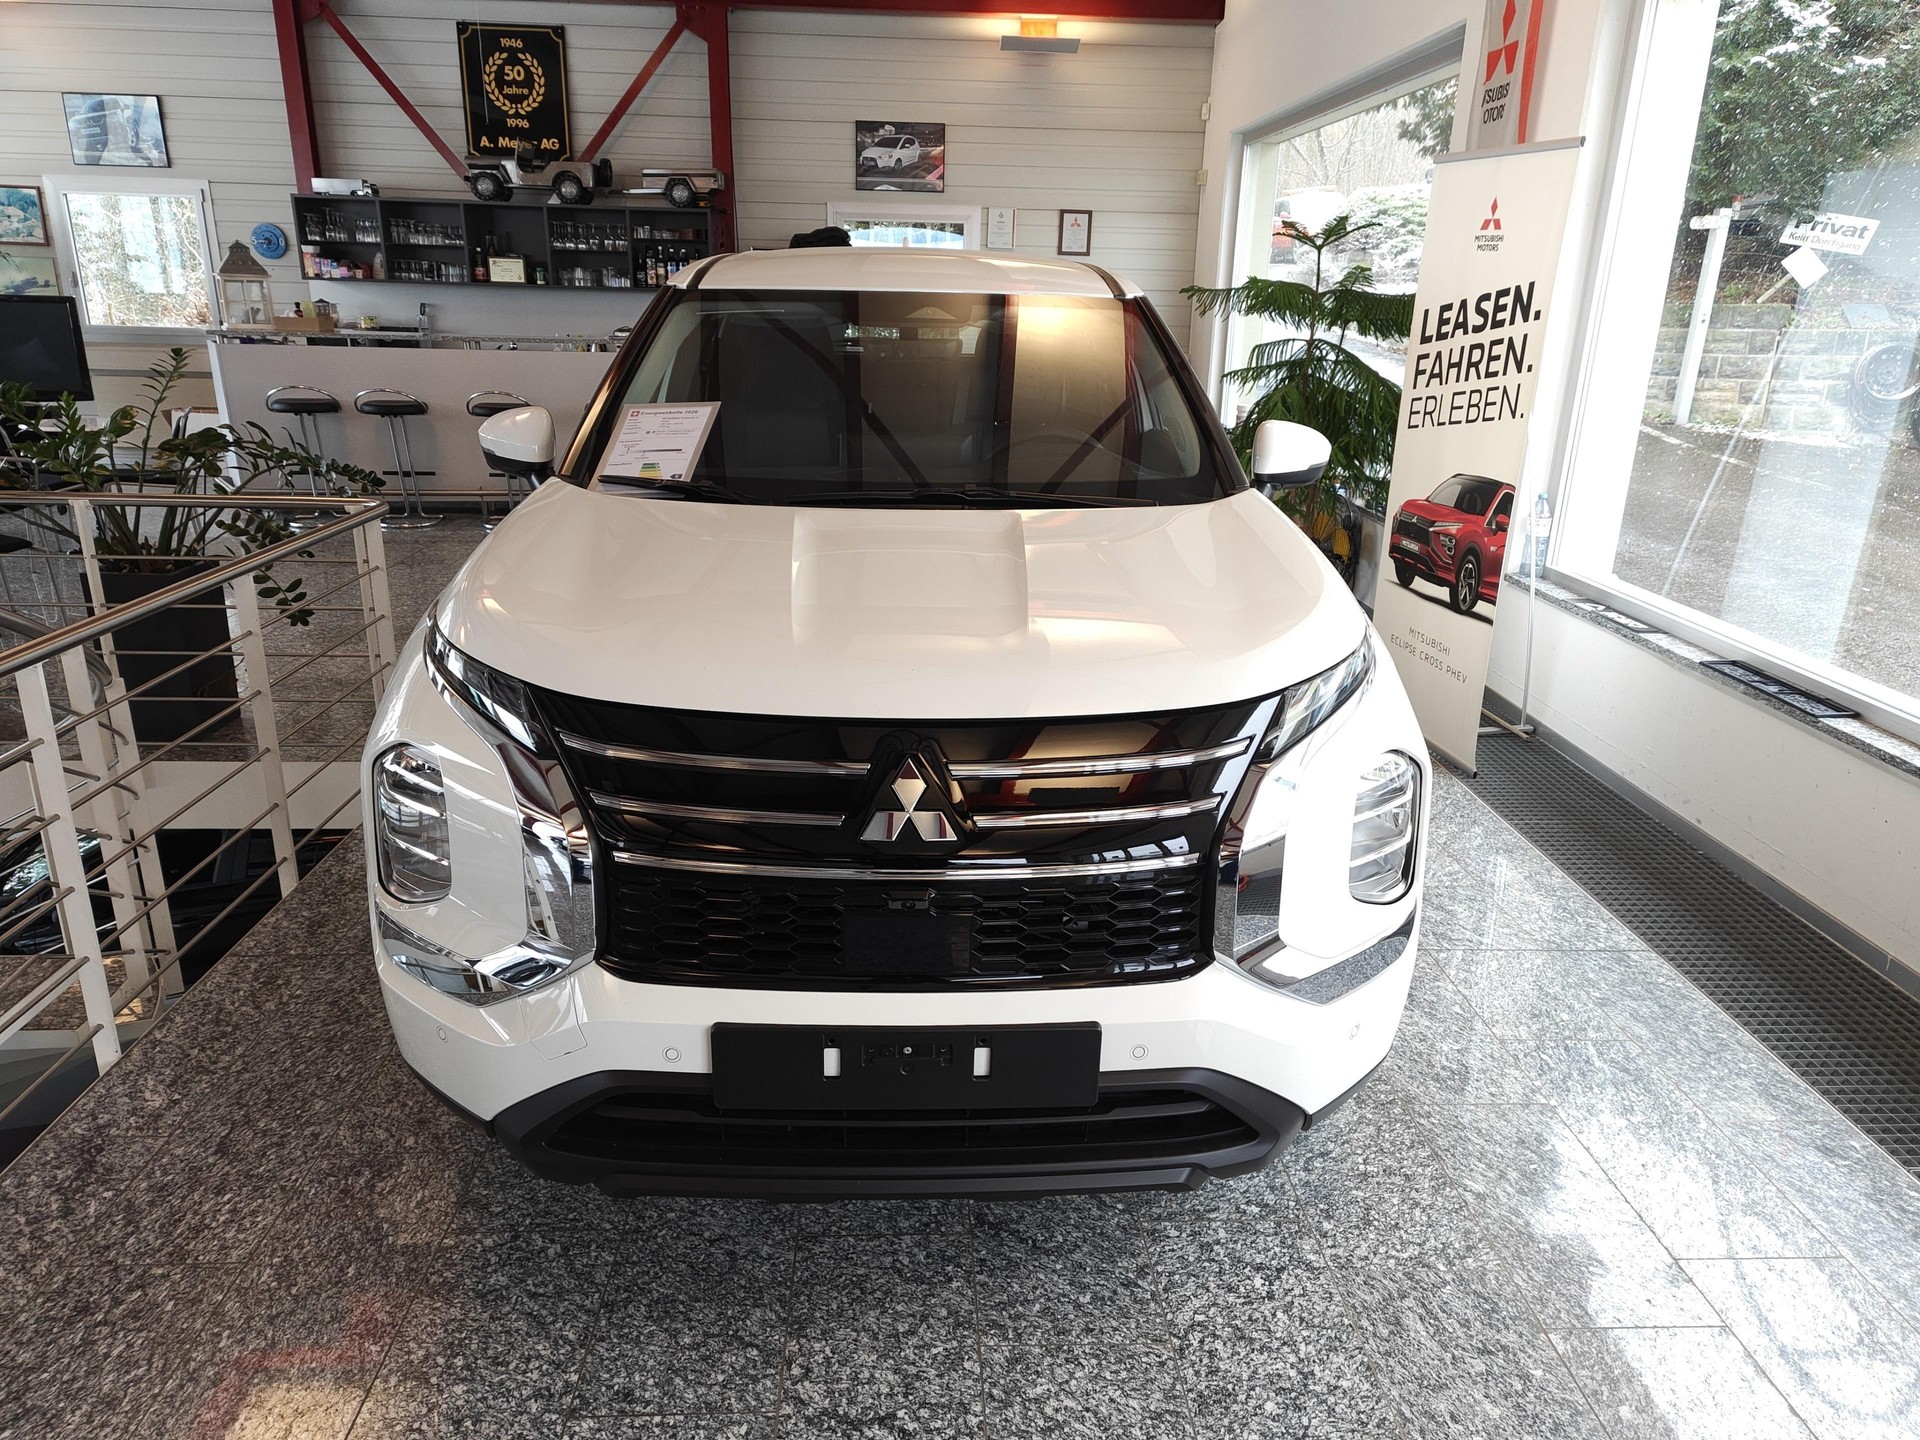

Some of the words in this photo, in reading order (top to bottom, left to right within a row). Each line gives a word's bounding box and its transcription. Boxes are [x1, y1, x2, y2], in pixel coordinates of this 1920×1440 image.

[500, 38, 523, 48] 1946
[503, 66, 525, 81] 50
[502, 85, 529, 95] Jahre
[506, 118, 530, 129] 1996
[480, 136, 494, 148] A.
[540, 138, 560, 150] AG
[1794, 213, 1870, 239] Privat
[1474, 234, 1504, 243] MITSUBISHI
[1788, 231, 1811, 243] Kein
[1476, 243, 1500, 252] MOTORS
[1419, 281, 1542, 345] LEASEN.
[1412, 333, 1533, 390] FAHREN.
[1407, 383, 1525, 430] ERLEBEN.
[1408, 626, 1451, 657] MITSUBISHI
[1390, 633, 1417, 657] ECLIPSE
[1419, 650, 1444, 671] CROSS
[1445, 665, 1468, 684] PHEV
